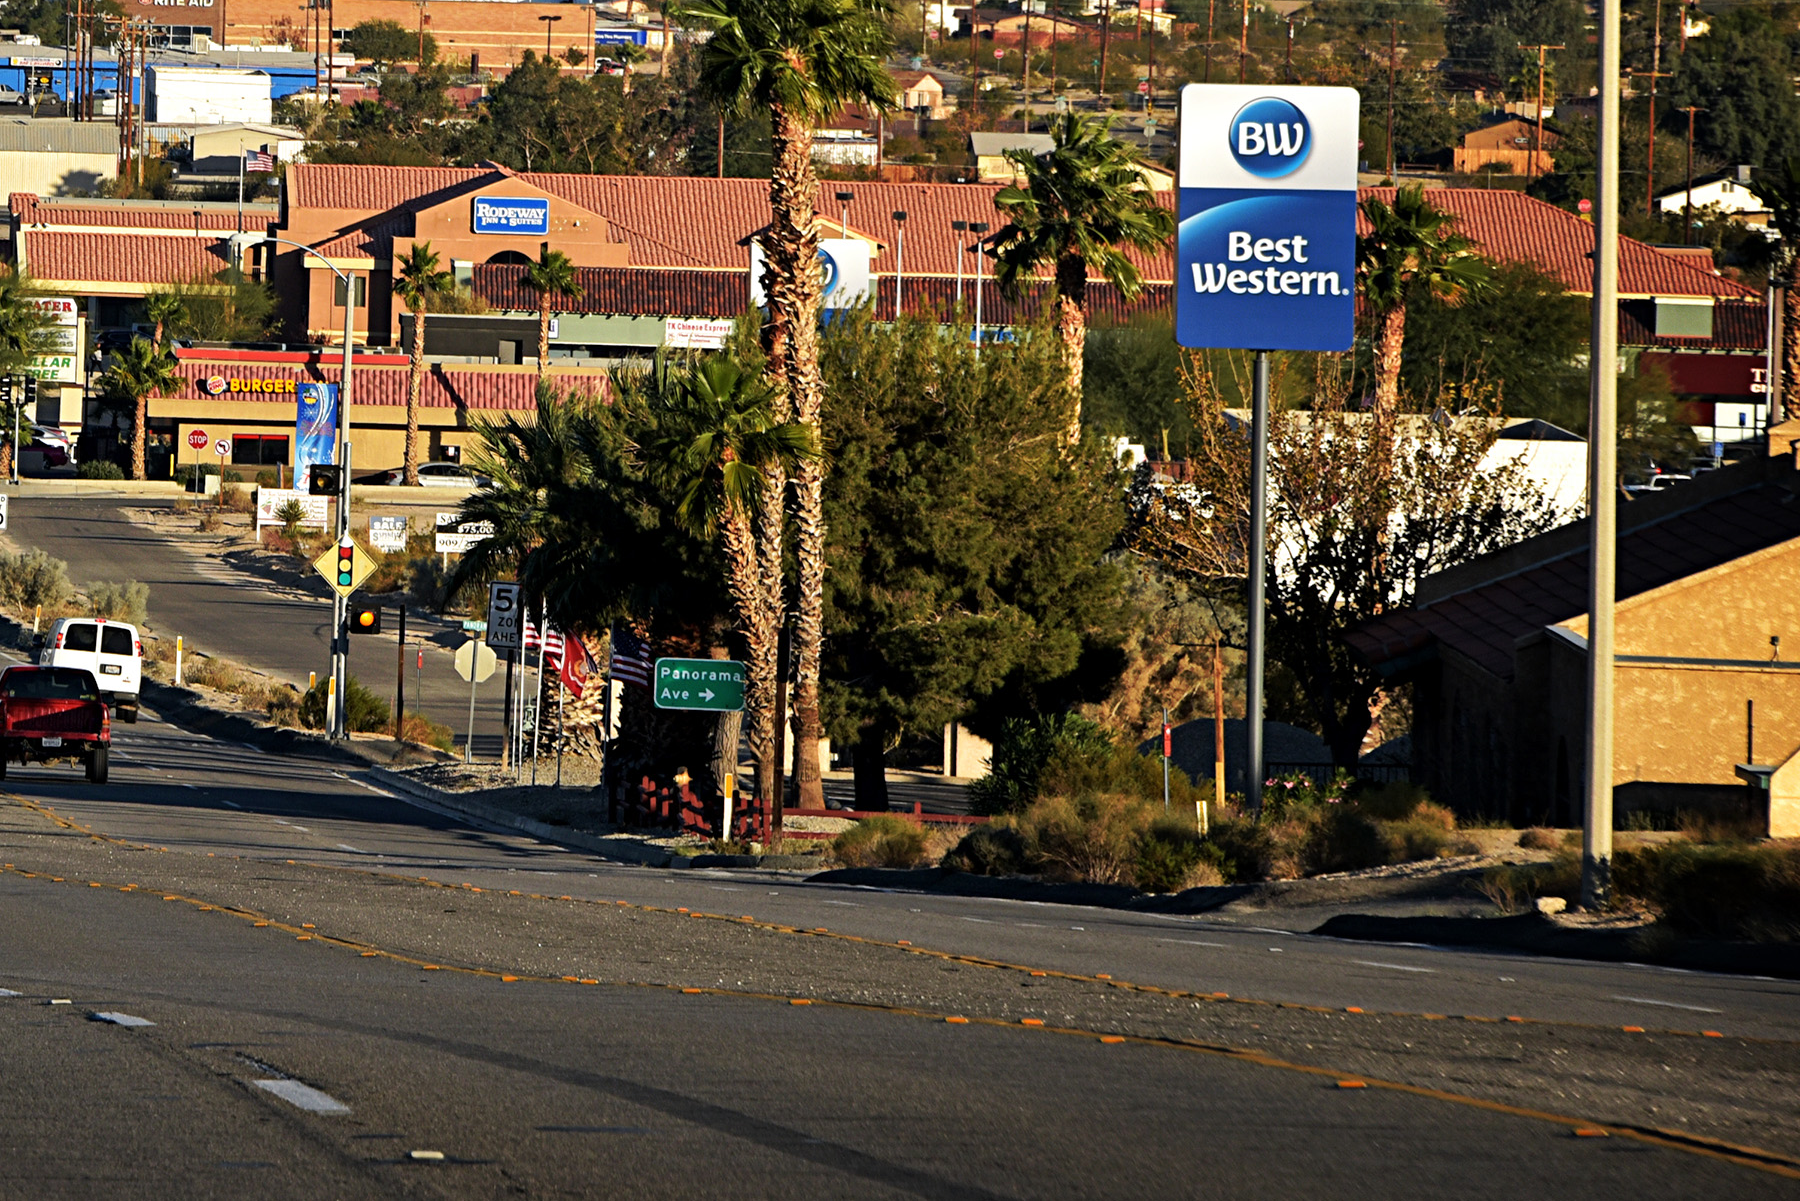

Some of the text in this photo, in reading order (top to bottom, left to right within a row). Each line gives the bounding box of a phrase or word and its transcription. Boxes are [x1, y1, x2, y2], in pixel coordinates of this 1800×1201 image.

[1238, 122, 1304, 156] BW
[477, 203, 546, 218] RODEWAY
[1228, 231, 1308, 263] Best
[1191, 262, 1342, 296] Western
[33, 301, 72, 312] ATER
[667, 322, 732, 332] TK Chinese Express
[31, 357, 72, 368] LLAR
[230, 378, 295, 393] BURGER
[189, 435, 207, 444] STOP
[373, 521, 404, 530] SALE
[494, 588, 514, 613] 5
[491, 631, 516, 643] AHE
[660, 666, 741, 681] Panorama
[660, 687, 690, 700] Ave
